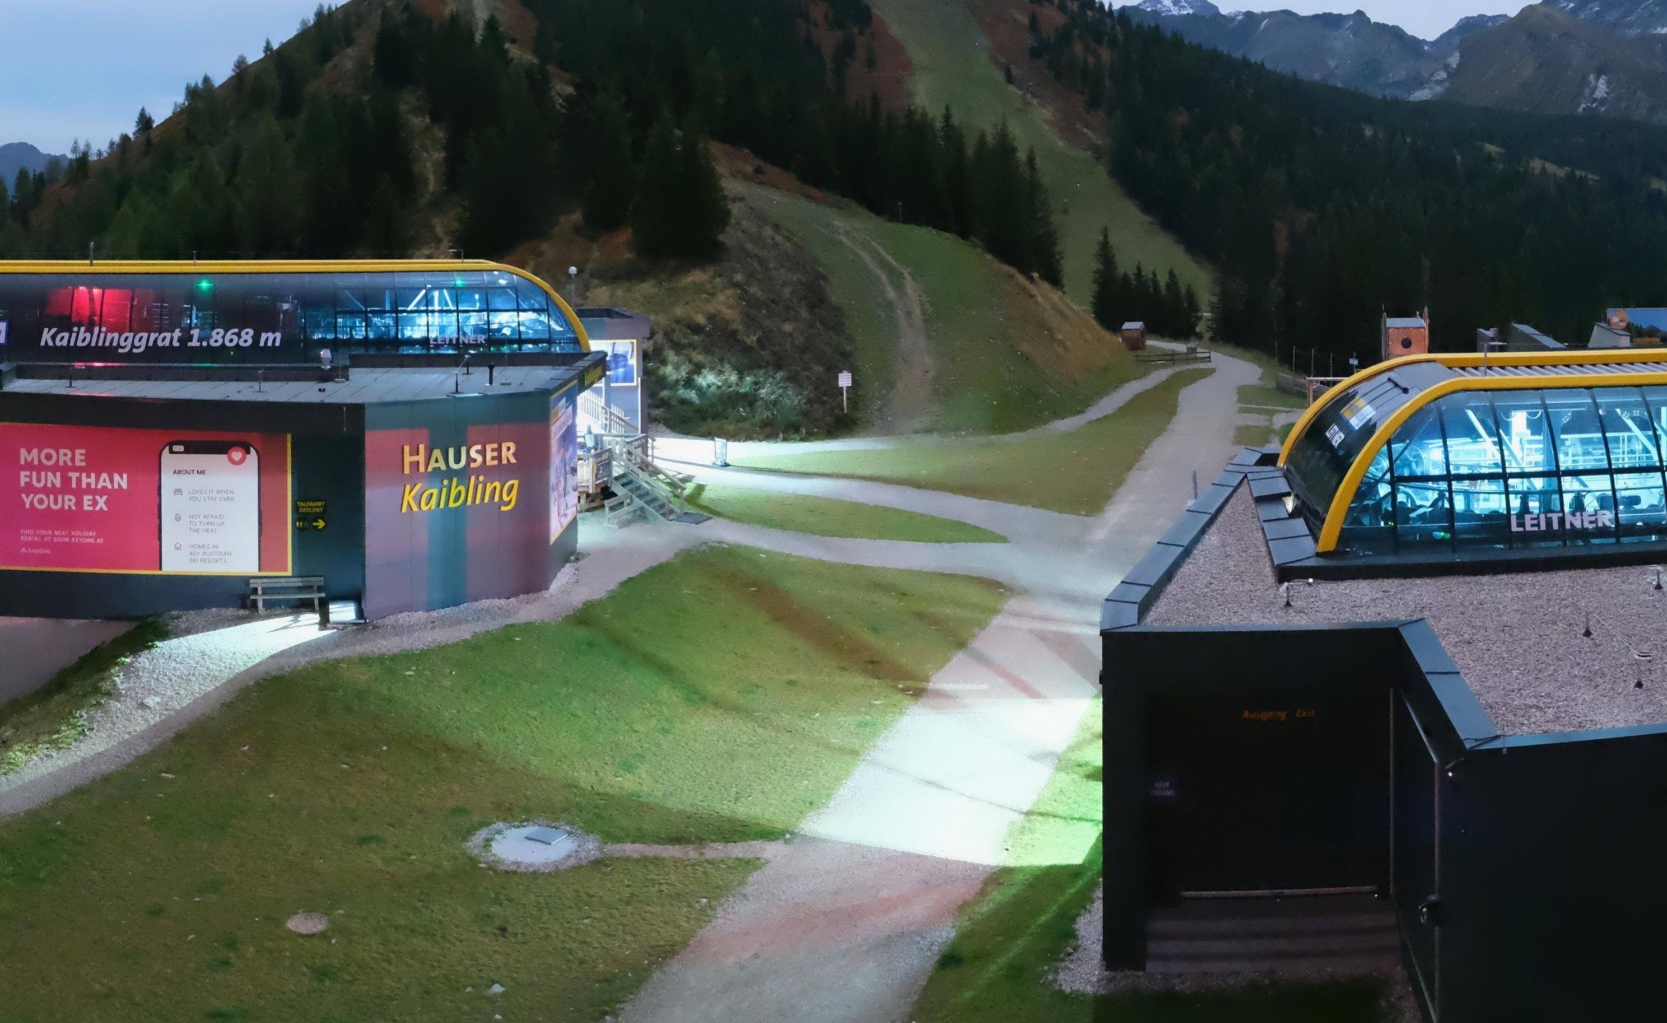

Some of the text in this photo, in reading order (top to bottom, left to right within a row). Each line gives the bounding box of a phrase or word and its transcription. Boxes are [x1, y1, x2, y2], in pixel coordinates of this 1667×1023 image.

[39, 327, 282, 353] Kaiblinggrat 1.868 m
[429, 335, 486, 345] LEITNER
[20, 448, 86, 466] MORE
[402, 441, 518, 475] HAUSER
[20, 471, 128, 489] FUN THAN
[21, 494, 108, 511] YOUR EX
[401, 475, 520, 513] Kaibling
[1510, 510, 1614, 532] LEITNER
